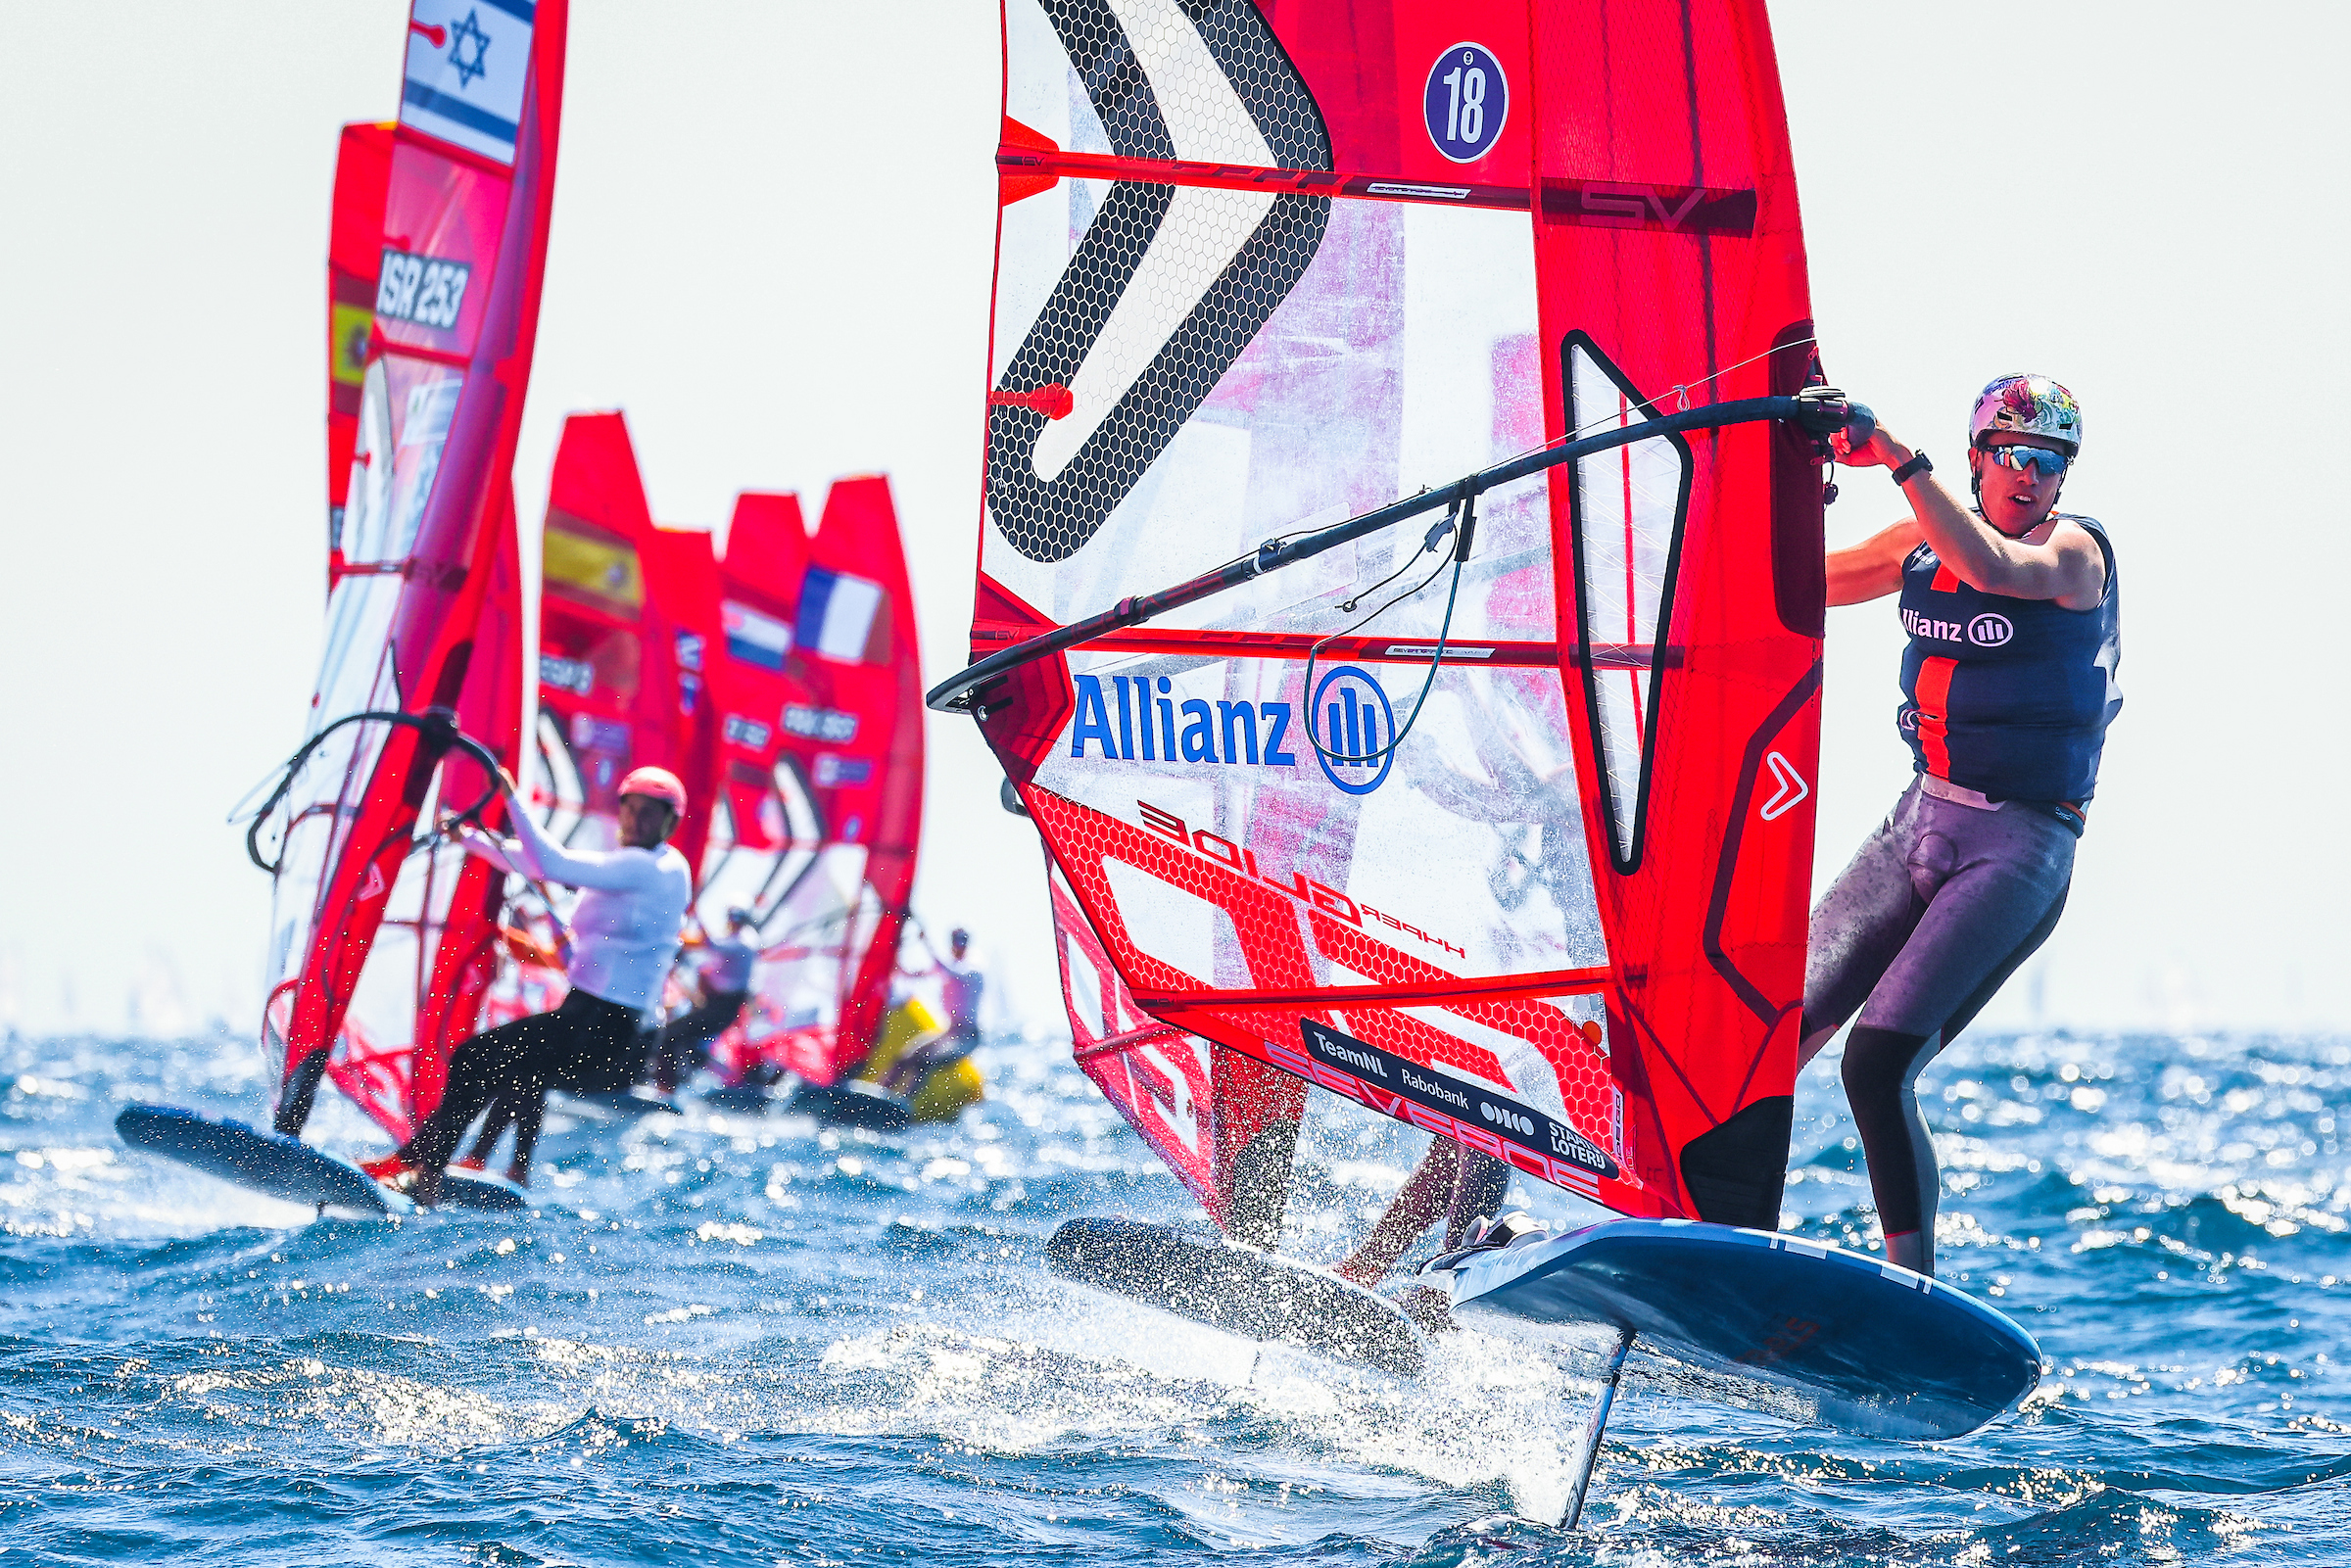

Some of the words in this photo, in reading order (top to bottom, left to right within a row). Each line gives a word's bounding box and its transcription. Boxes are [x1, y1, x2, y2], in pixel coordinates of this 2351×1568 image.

[1443, 67, 1487, 144] 18
[1580, 182, 1706, 230] SV
[376, 252, 423, 319] ISR
[414, 261, 469, 328] 253
[1898, 608, 1963, 642] llianz
[1071, 674, 1296, 767] Allianz
[1313, 1031, 1388, 1078] TeamNL
[1401, 1068, 1469, 1111] Rabobank
